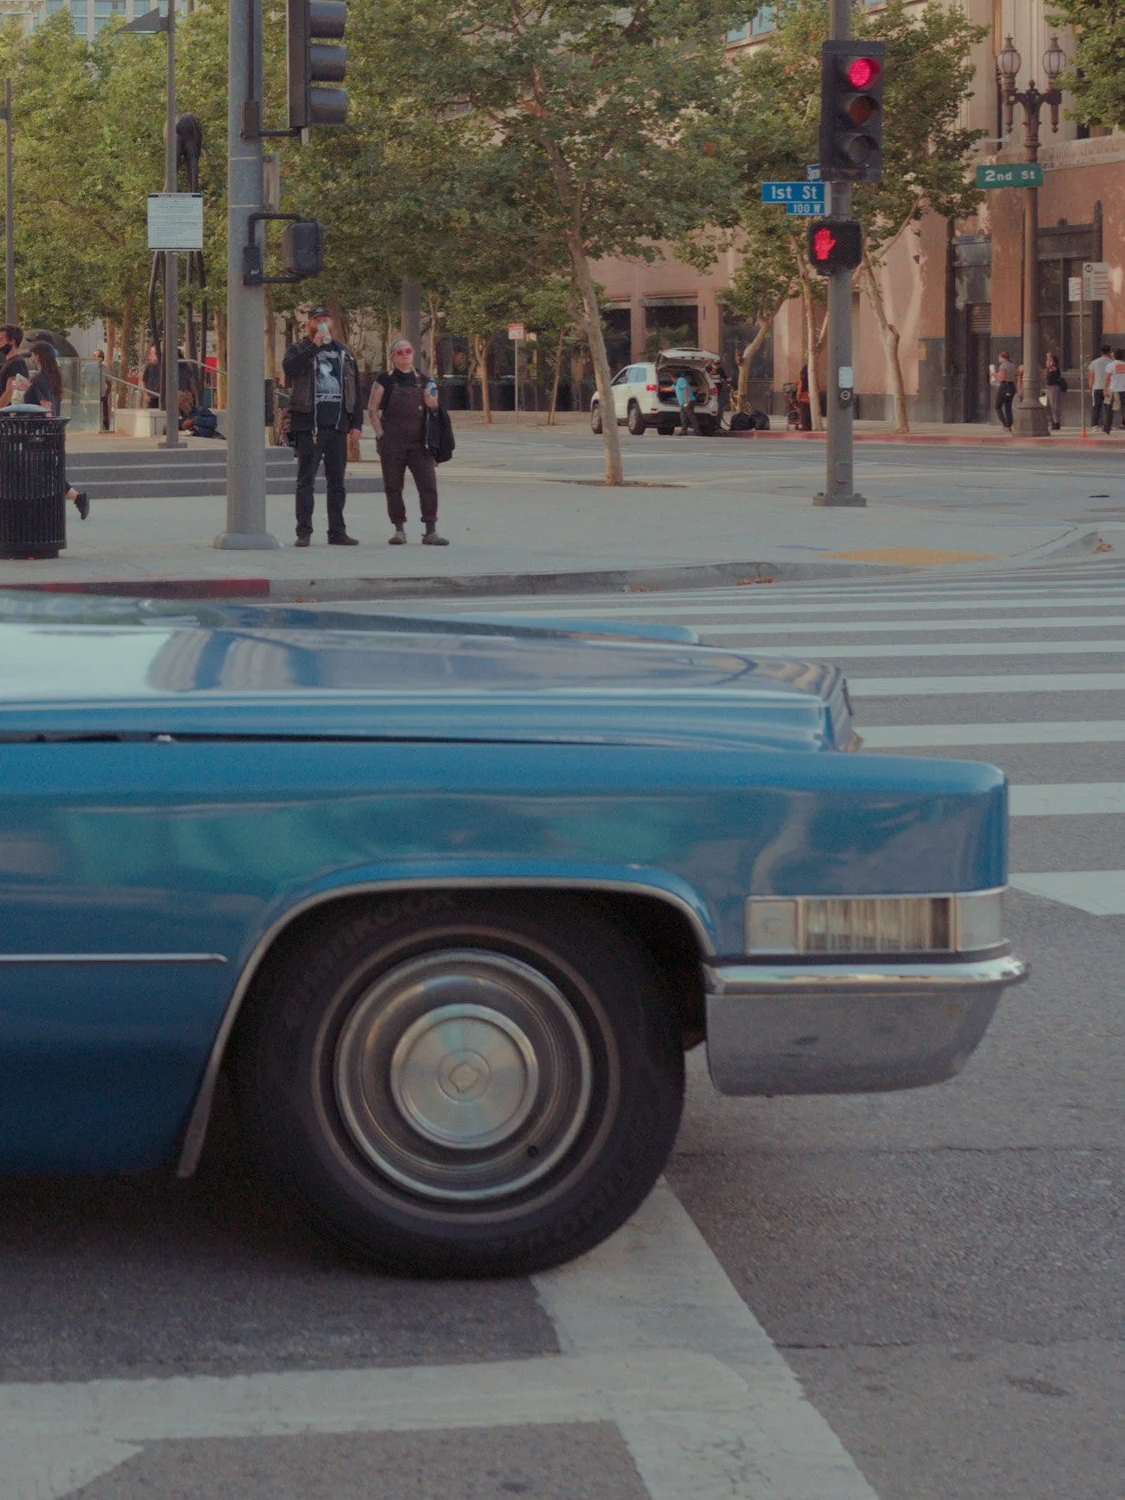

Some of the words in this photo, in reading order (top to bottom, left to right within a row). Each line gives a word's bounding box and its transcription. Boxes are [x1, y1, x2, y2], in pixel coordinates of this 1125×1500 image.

[985, 170, 1012, 182] 2nd
[1021, 170, 1035, 180] St
[771, 186, 792, 199] 1st
[802, 186, 818, 199] St
[793, 204, 810, 213] 100
[814, 204, 821, 213] W
